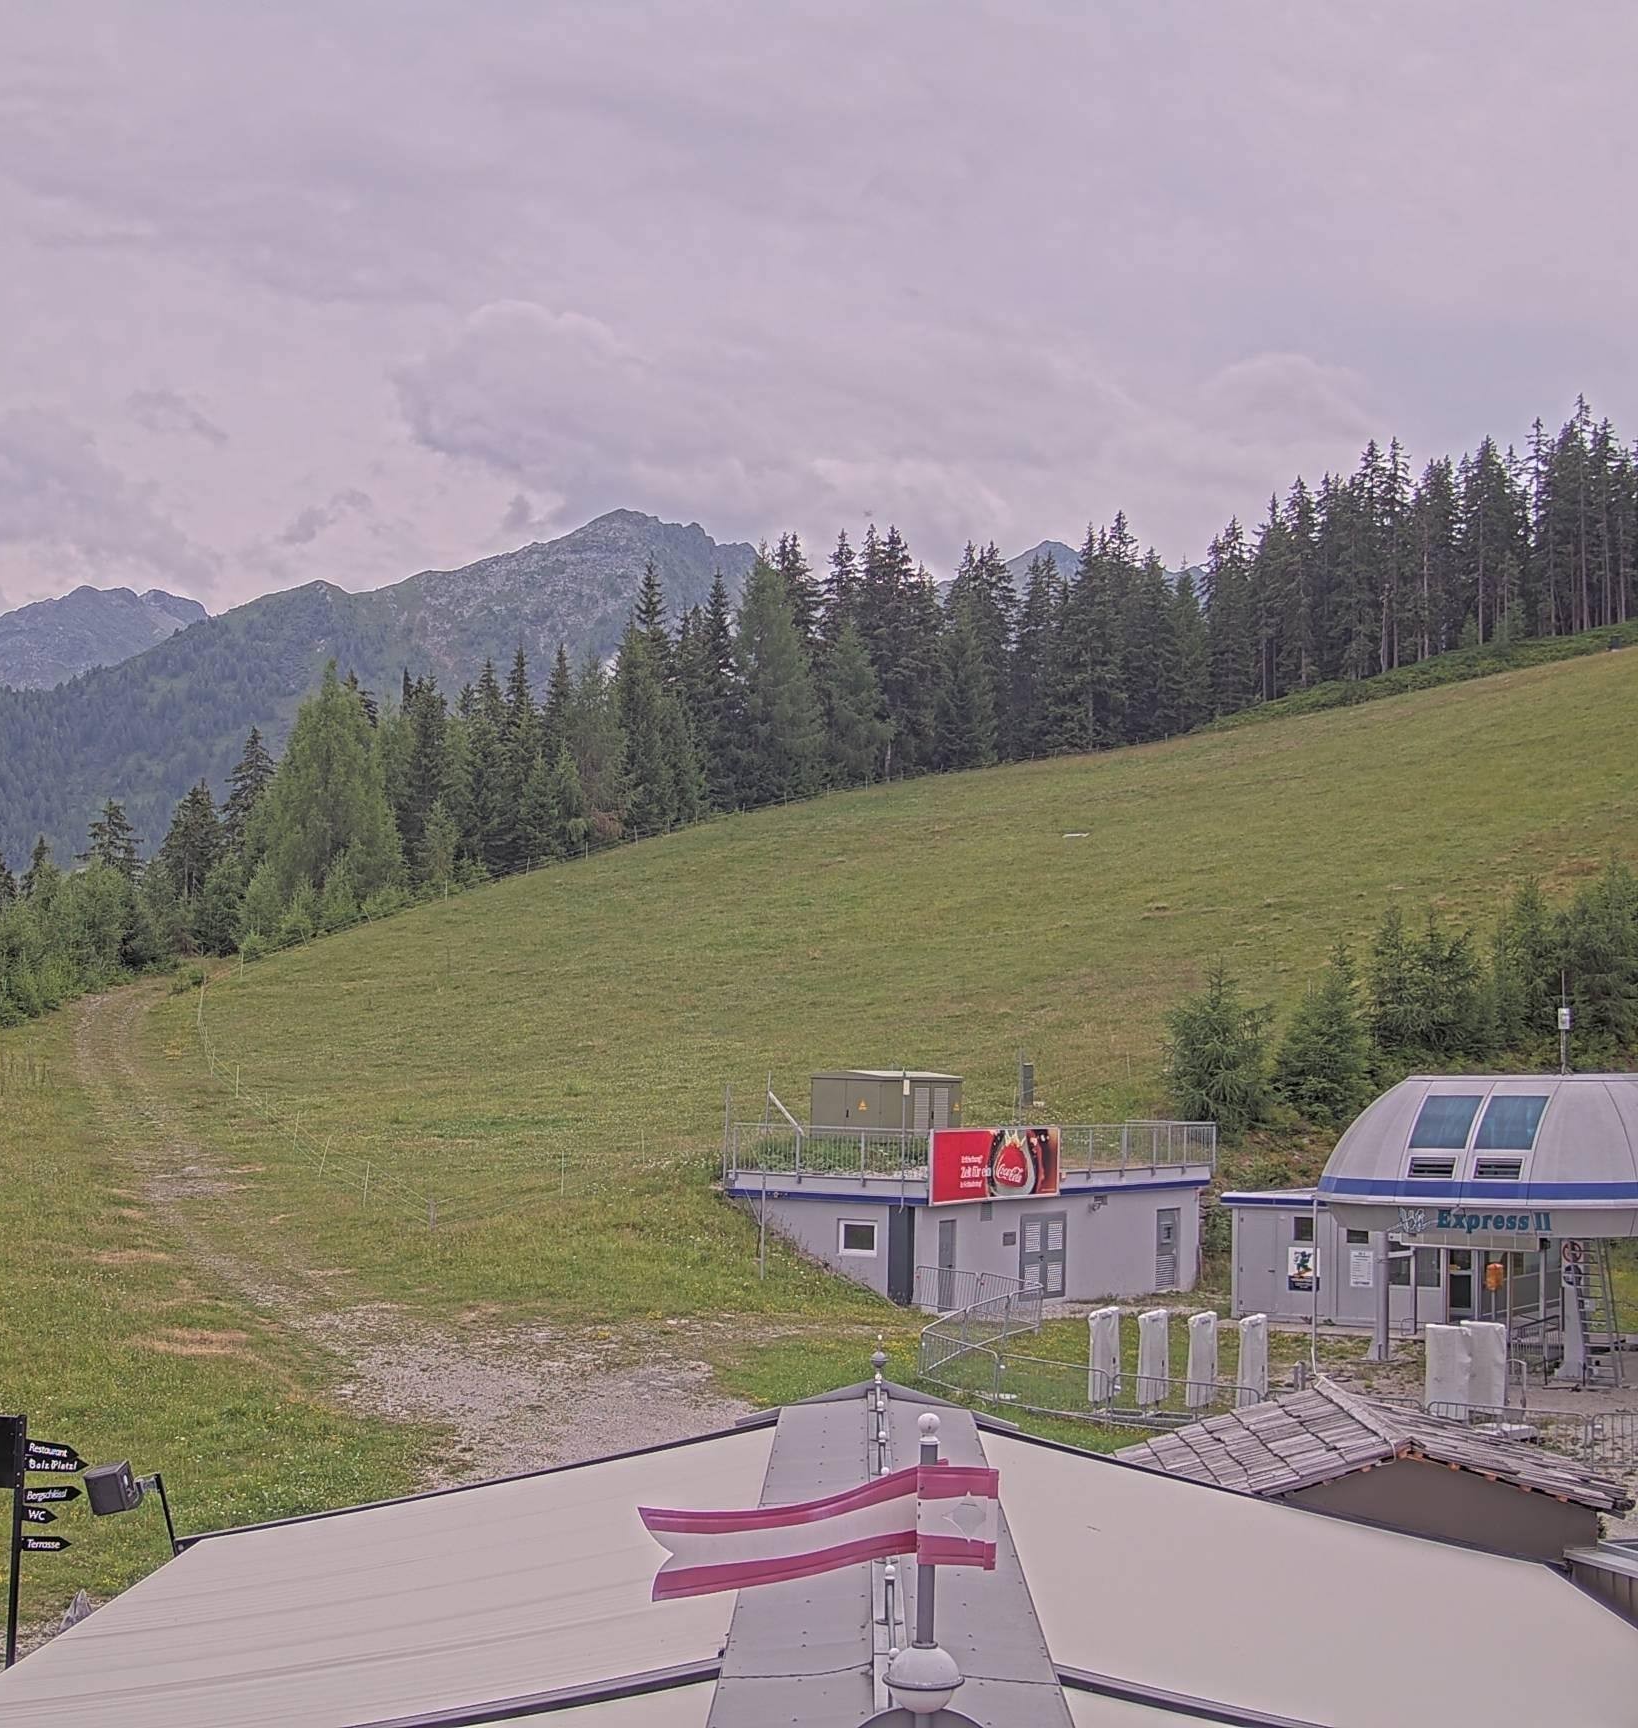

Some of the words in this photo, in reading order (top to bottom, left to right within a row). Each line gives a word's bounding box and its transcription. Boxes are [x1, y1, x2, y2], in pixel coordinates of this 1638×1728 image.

[1437, 1208, 1530, 1234] Express
[1533, 1211, 1552, 1232] II
[28, 1443, 68, 1457] Restaurant
[28, 1509, 46, 1521] WC
[27, 1538, 61, 1549] Terrasse
